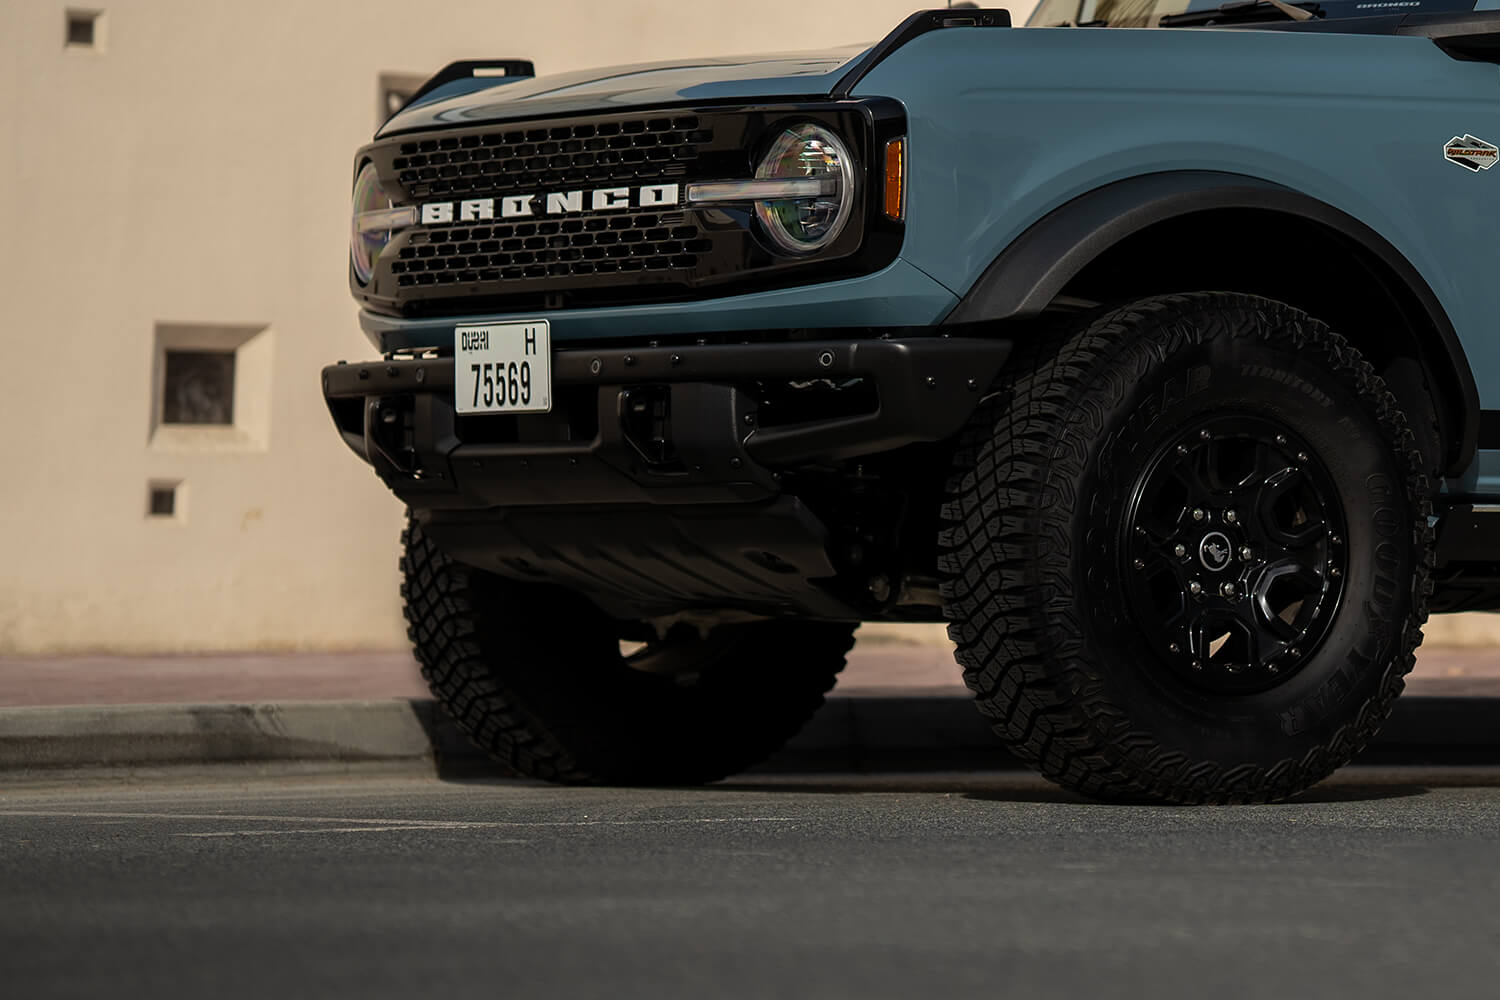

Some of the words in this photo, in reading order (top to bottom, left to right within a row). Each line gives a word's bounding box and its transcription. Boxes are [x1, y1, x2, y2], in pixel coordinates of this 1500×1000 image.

[1356, 1, 1421, 9] BRONCO
[421, 184, 679, 224] BRONCO
[461, 331, 489, 351] DUBAI
[524, 328, 536, 355] H
[471, 361, 530, 408] 75569
